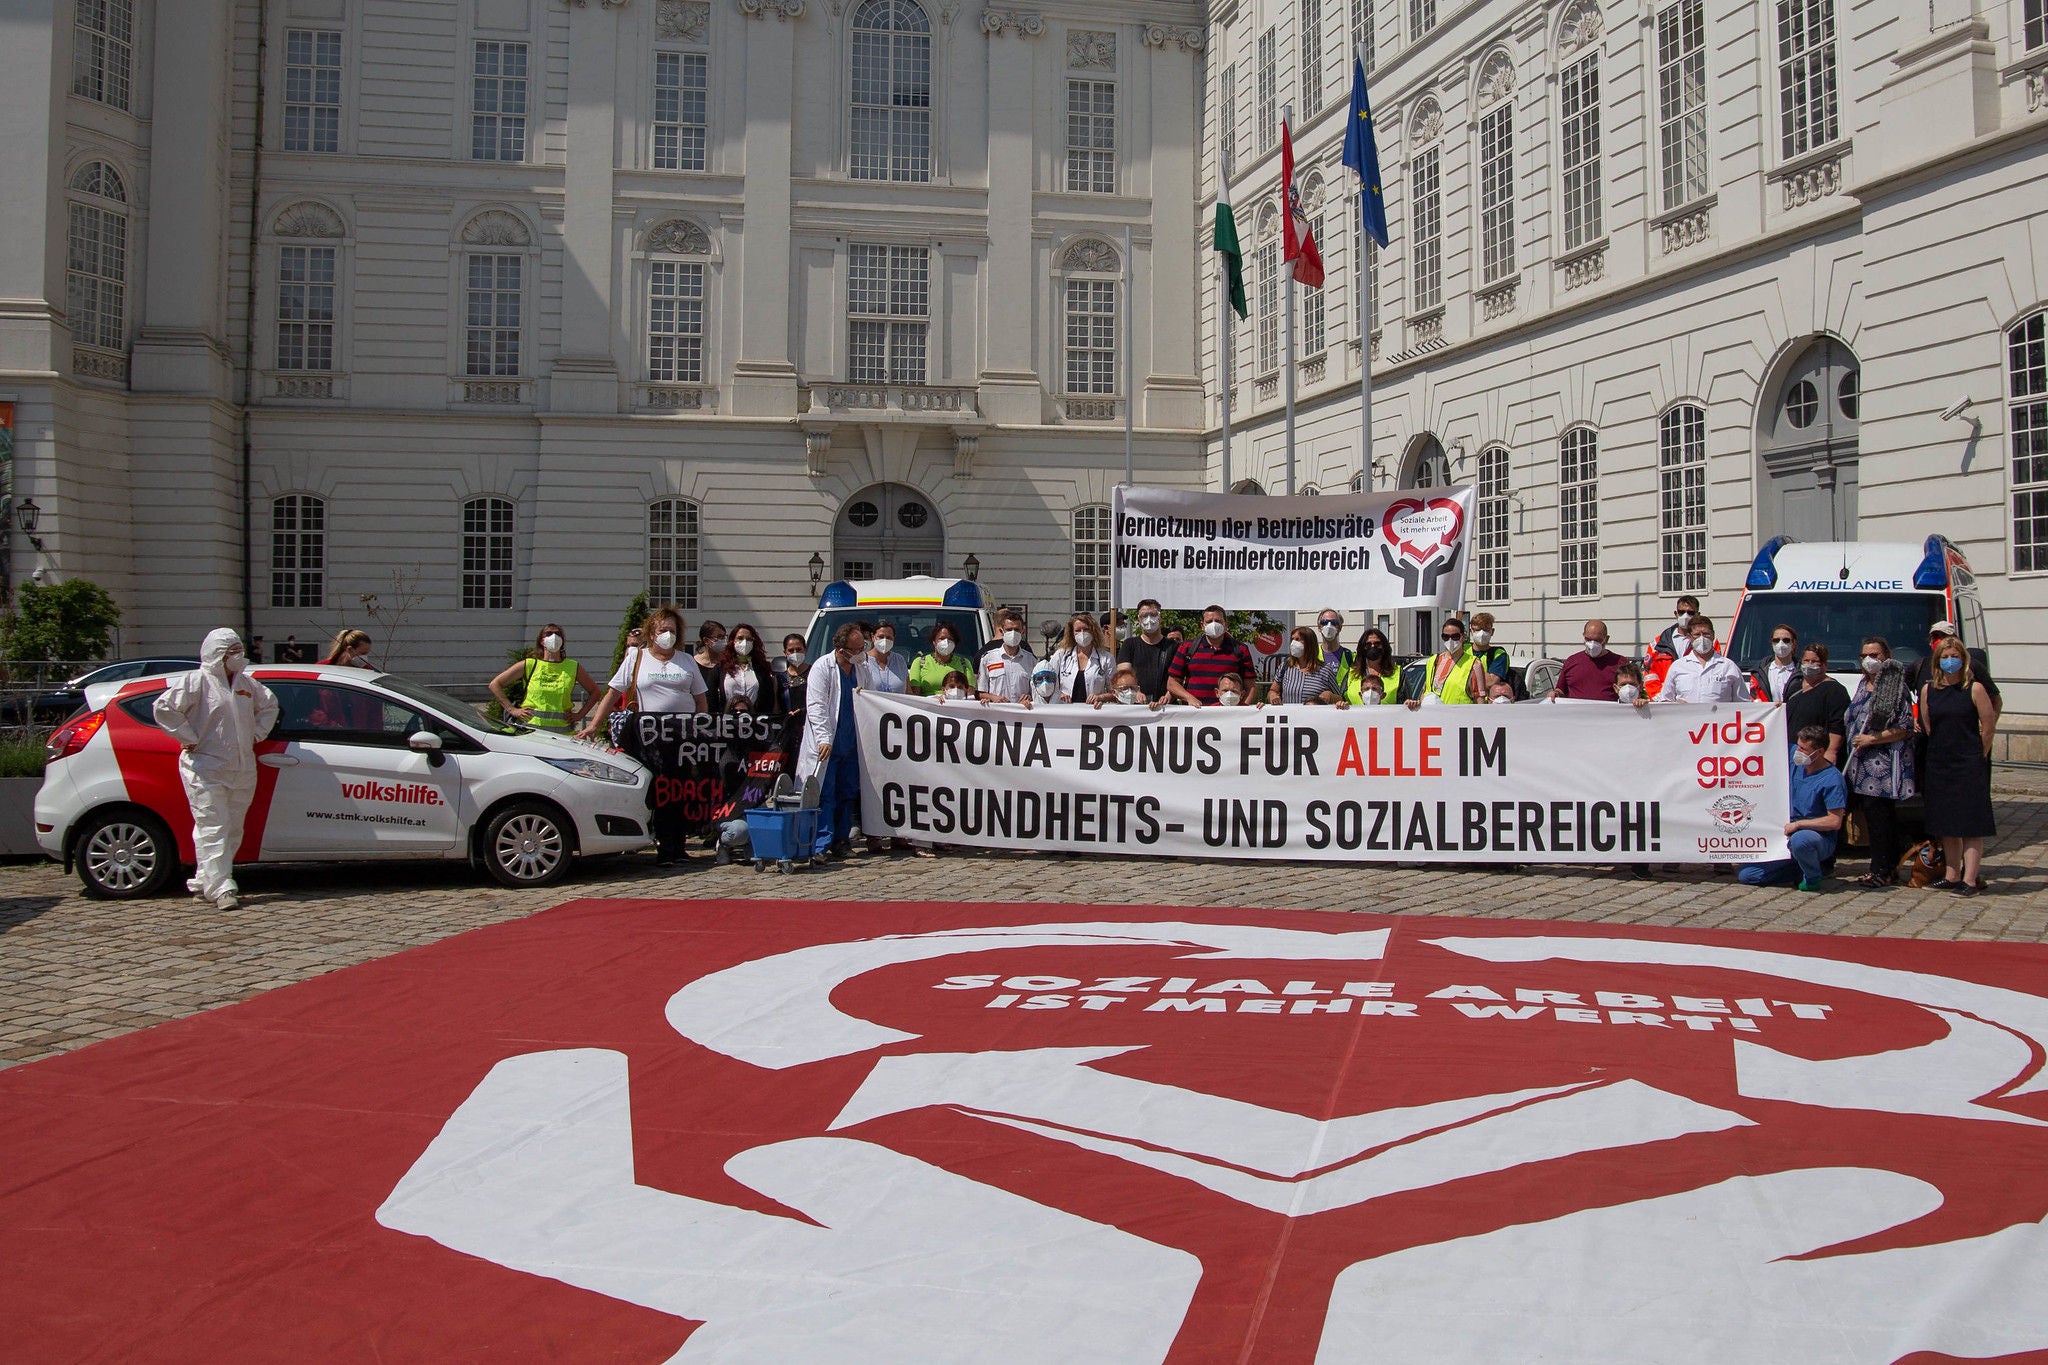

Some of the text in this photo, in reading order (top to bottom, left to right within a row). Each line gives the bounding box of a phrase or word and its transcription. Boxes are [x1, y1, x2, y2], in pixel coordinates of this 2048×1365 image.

[1116, 513, 1375, 541] Vernetzung der Betriebsräte
[1400, 526, 1409, 534] ist
[1410, 526, 1429, 534] mehr
[1116, 543, 1370, 571] Wiener Behindertenbereich
[1787, 580, 1904, 590] AMBULANCE
[640, 712, 781, 746] BETRIEBS-
[880, 712, 1507, 776] CORONA-BONUS FÜR ALLE IM
[1688, 711, 1766, 745] vida
[678, 742, 728, 767] RAT
[1697, 756, 1764, 788] gpa
[655, 775, 724, 808] BDACH
[306, 810, 427, 827] www.stmk.volkshilfe.at
[882, 782, 1662, 852] GESUNDHEITS- UND SOZIALBEREICH!
[1697, 836, 1767, 853] younion
[931, 974, 1835, 1020] SOZIALE ARBEIT
[985, 993, 1762, 1033] IST MEHR WERT!
